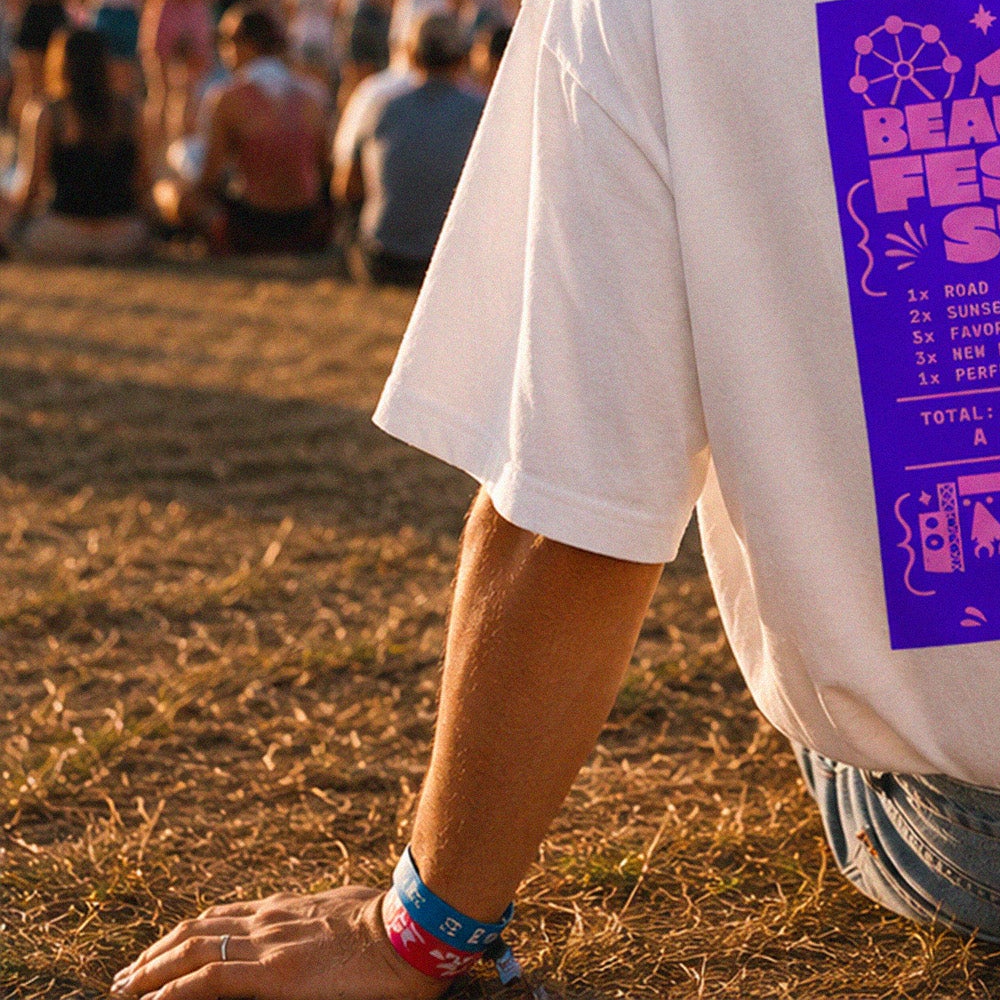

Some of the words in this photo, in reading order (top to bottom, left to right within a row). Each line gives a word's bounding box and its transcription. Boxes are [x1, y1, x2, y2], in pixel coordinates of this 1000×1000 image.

[907, 289, 929, 302] 1x
[944, 281, 989, 298] ROAD
[909, 309, 931, 324] 2x
[912, 331, 934, 345] 5x
[915, 351, 937, 366] 3x
[952, 345, 985, 361] NEW
[918, 373, 940, 386] 1x
[921, 406, 994, 426] TOTAL:
[973, 428, 988, 446] A
